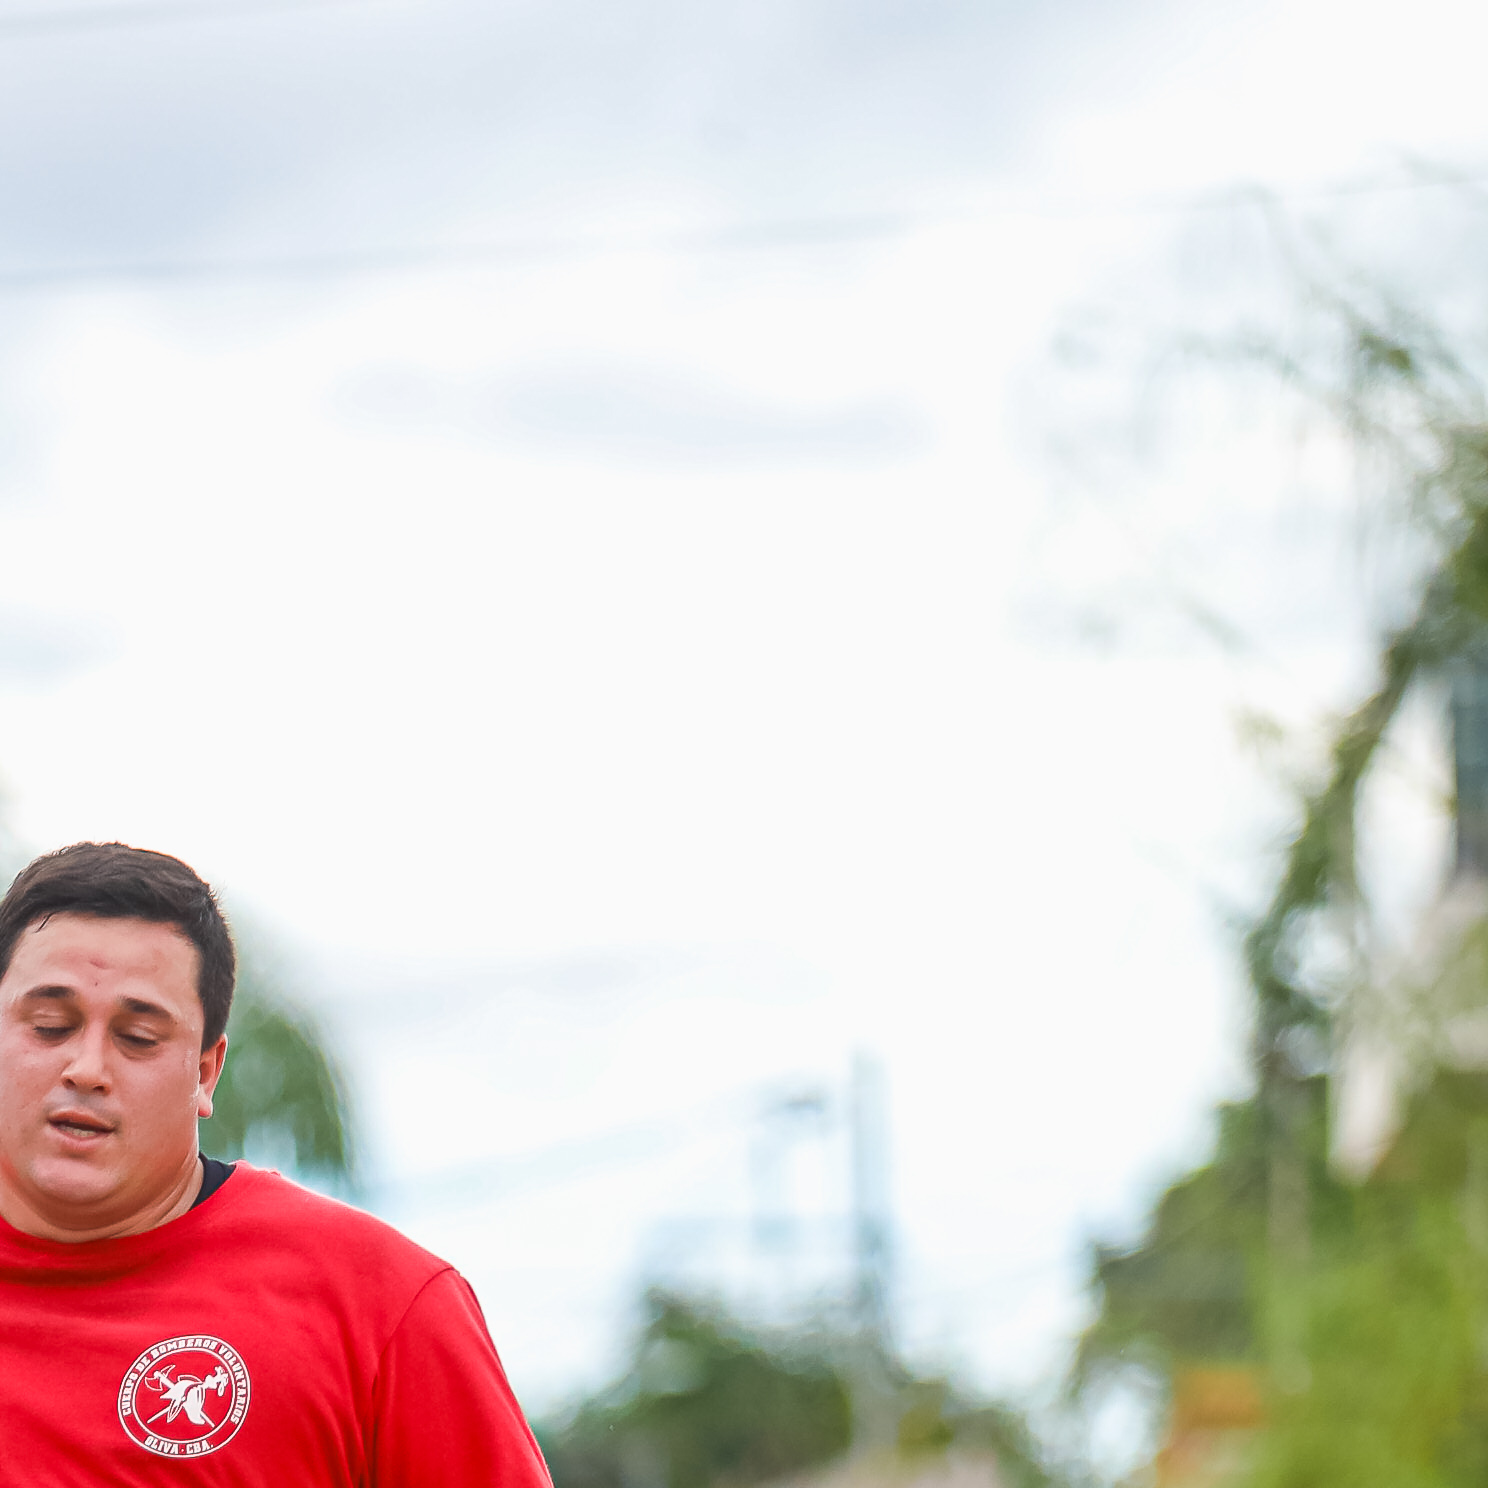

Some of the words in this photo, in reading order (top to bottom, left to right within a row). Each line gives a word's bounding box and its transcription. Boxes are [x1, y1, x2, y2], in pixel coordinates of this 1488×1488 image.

[121, 1372, 139, 1416] CUERPO
[134, 1356, 151, 1373] DE
[150, 1338, 218, 1359] BOMBEROS
[218, 1344, 247, 1425] VOLUNTARIOS
[144, 1435, 179, 1455] OLIVA
